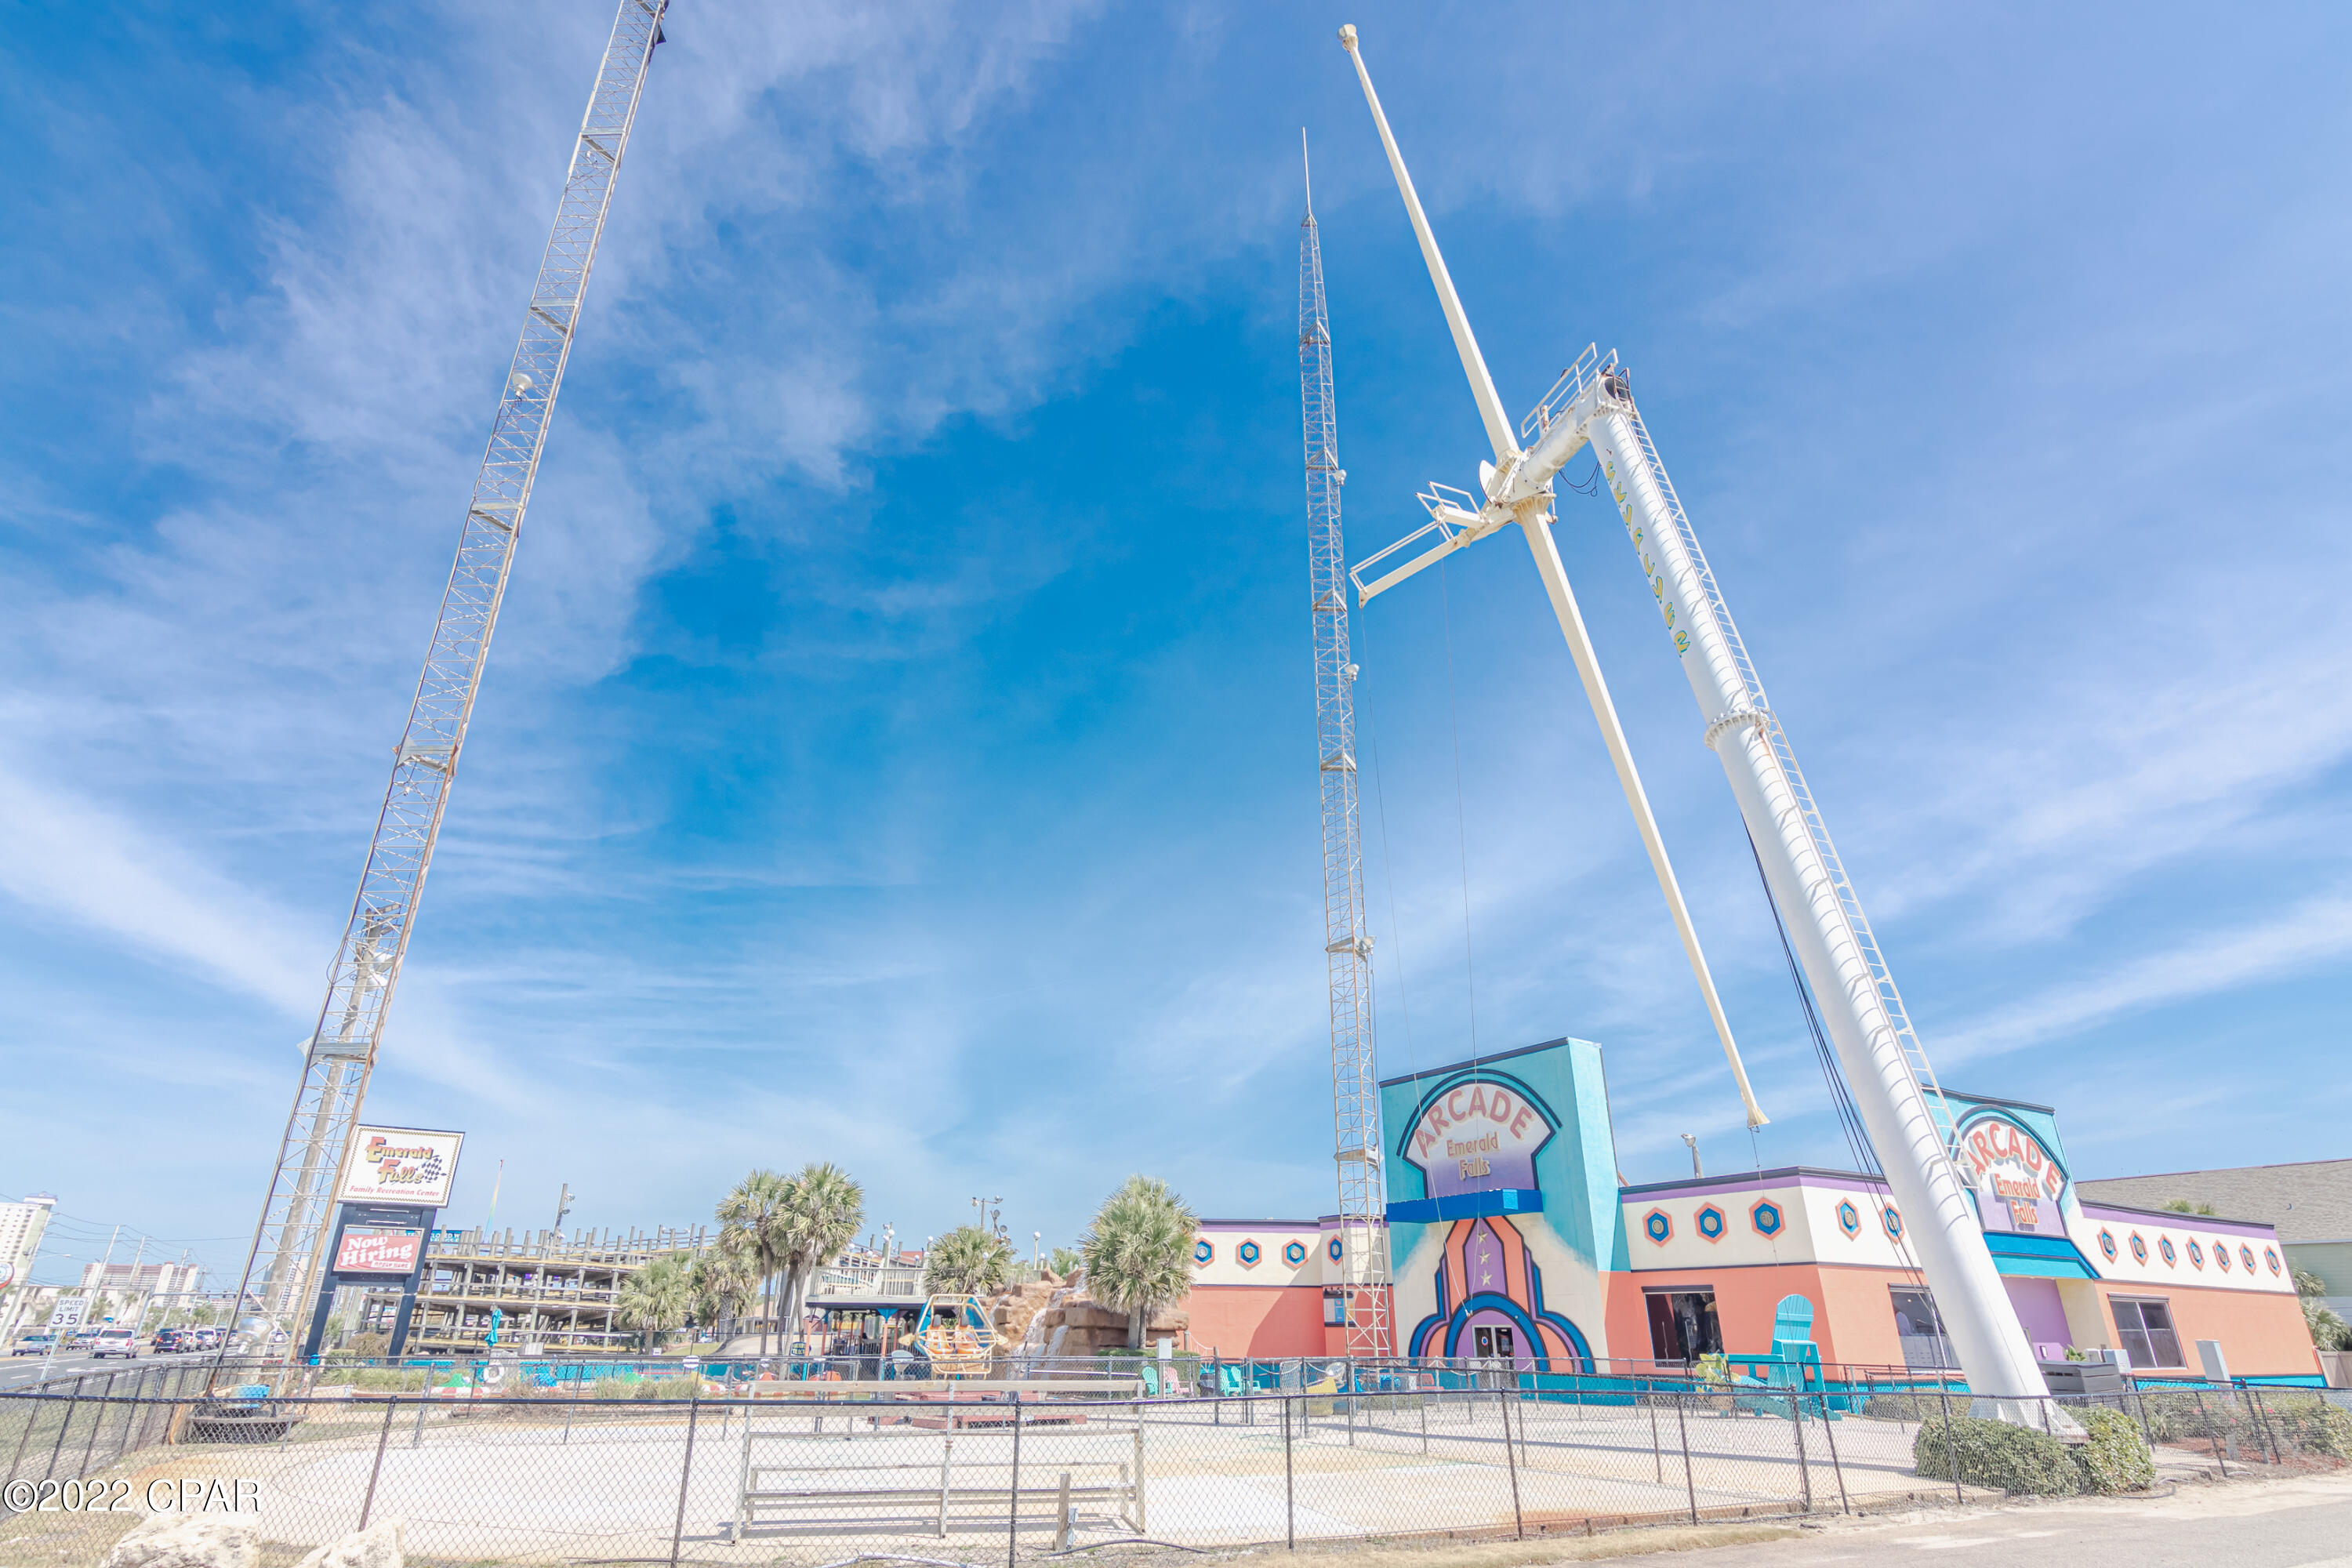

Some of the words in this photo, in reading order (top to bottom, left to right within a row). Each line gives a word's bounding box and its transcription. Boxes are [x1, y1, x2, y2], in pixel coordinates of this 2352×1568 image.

[1414, 1086, 1532, 1158] ARCADE
[365, 1137, 434, 1163] Emerald
[1446, 1131, 1499, 1157] Emerald
[1459, 1156, 1490, 1180] Falls
[1967, 1123, 2060, 1194] ARCADE
[377, 1160, 424, 1184] Falls
[350, 1185, 375, 1194] Family
[376, 1187, 415, 1196] Recreation
[1994, 1174, 2040, 1199] Emerald
[2010, 1200, 2038, 1224] Falls
[341, 1243, 413, 1265] Hiring
[347, 1237, 387, 1251] Now
[52, 1313, 78, 1325] 35
